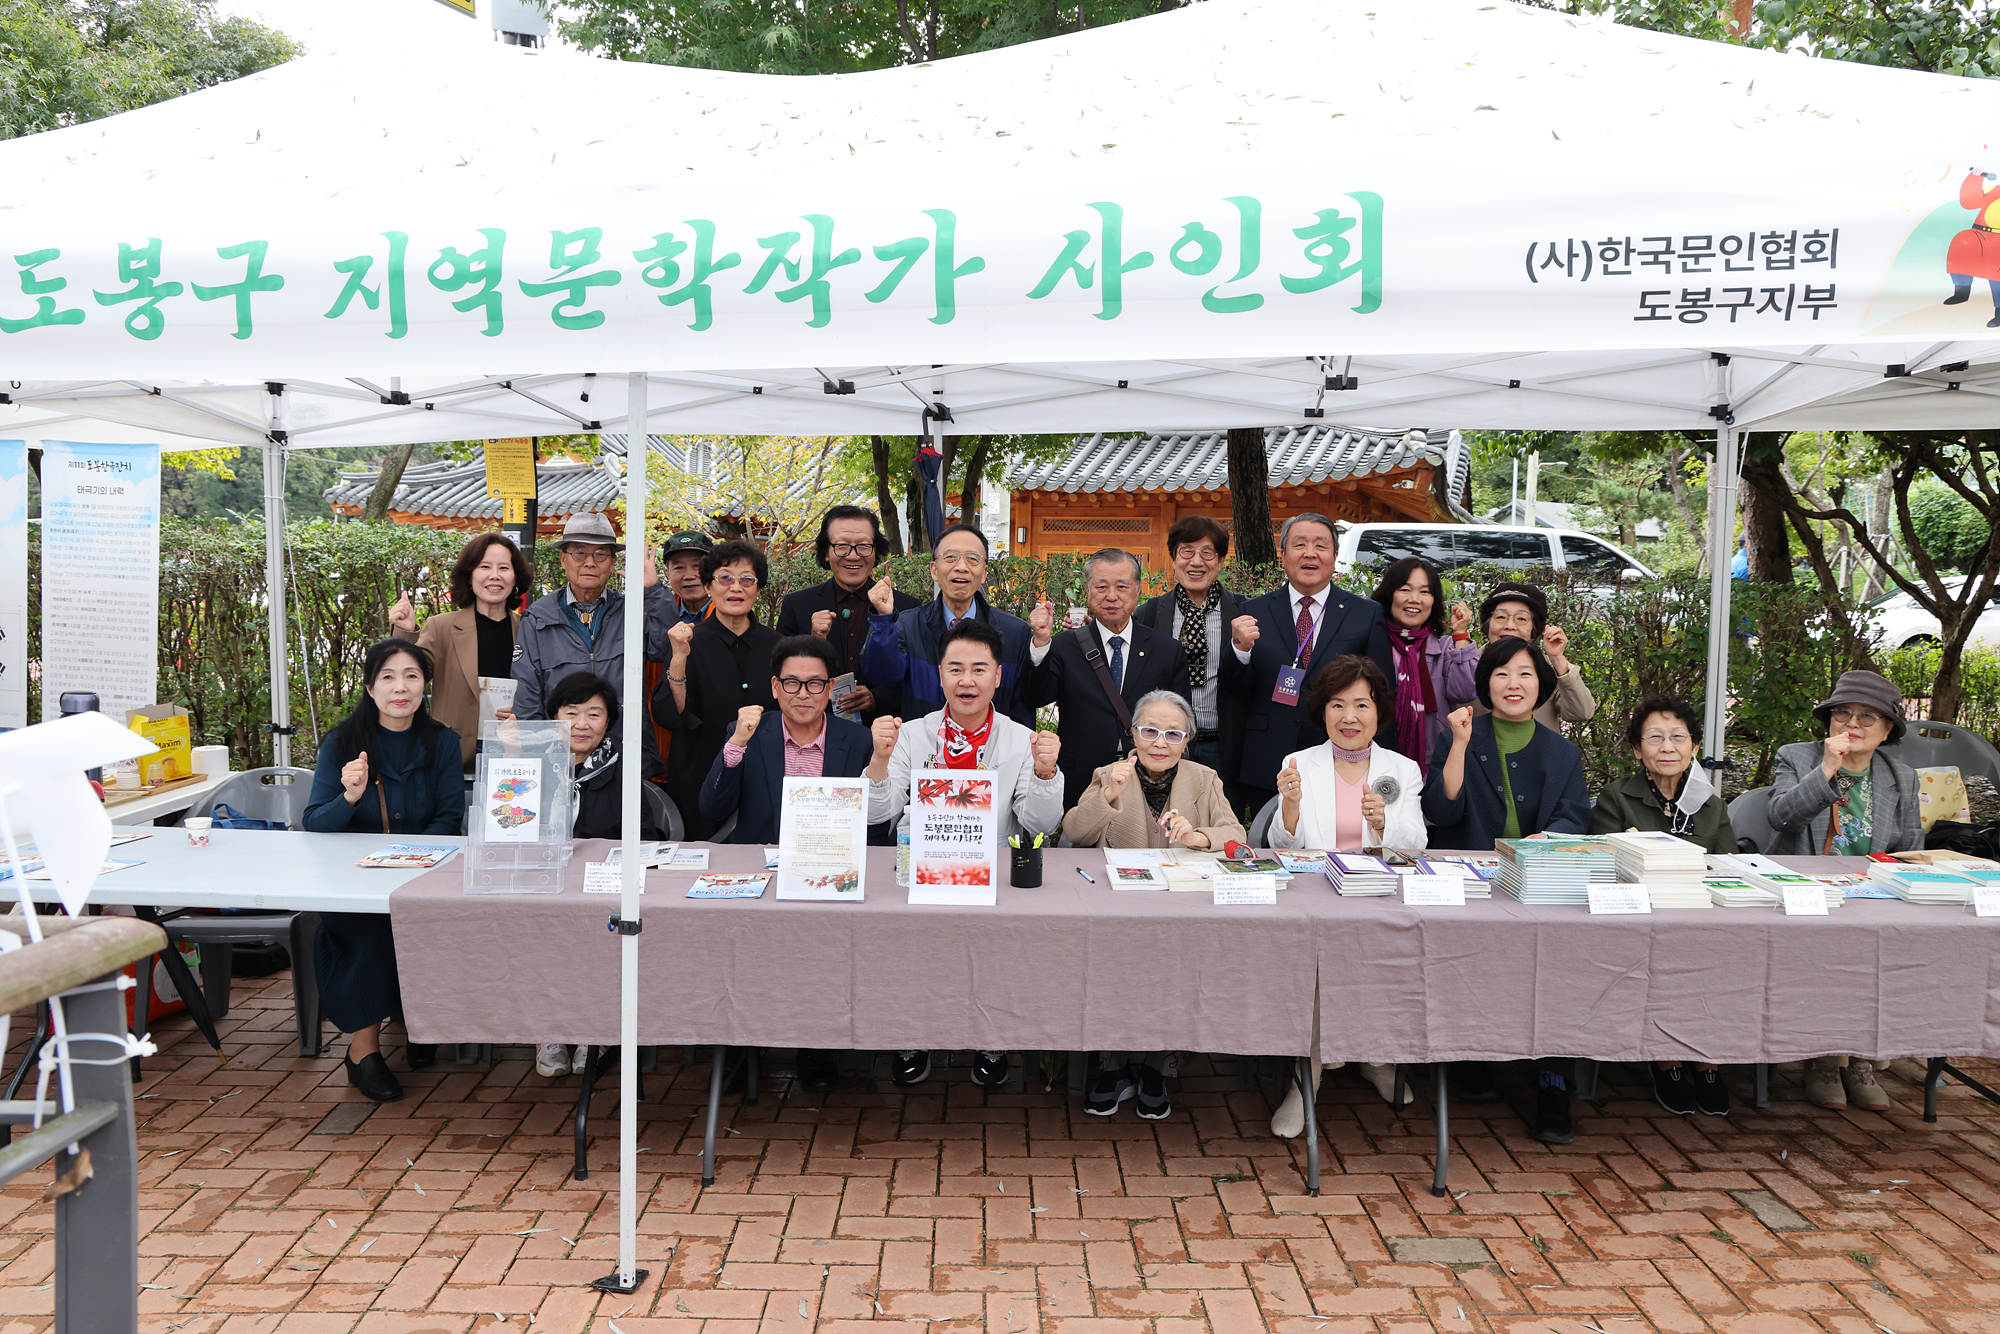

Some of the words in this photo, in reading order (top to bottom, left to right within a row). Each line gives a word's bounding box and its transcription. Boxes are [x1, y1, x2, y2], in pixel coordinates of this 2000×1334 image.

[1526, 228, 1838, 284] (사)한국문인협회
[0, 238, 283, 339] 도봉구
[324, 209, 984, 338] 지역문학작가
[1026, 191, 1383, 319] 사인회
[1634, 284, 1838, 323] 도봉구지부
[68, 461, 86, 469] 제11회
[87, 460, 132, 473] 도봉한글잔치
[77, 485, 107, 496] 태극기의
[109, 487, 124, 496] 내력
[924, 823, 983, 834] 도봉문인협회
[953, 834, 983, 844] 시화전
